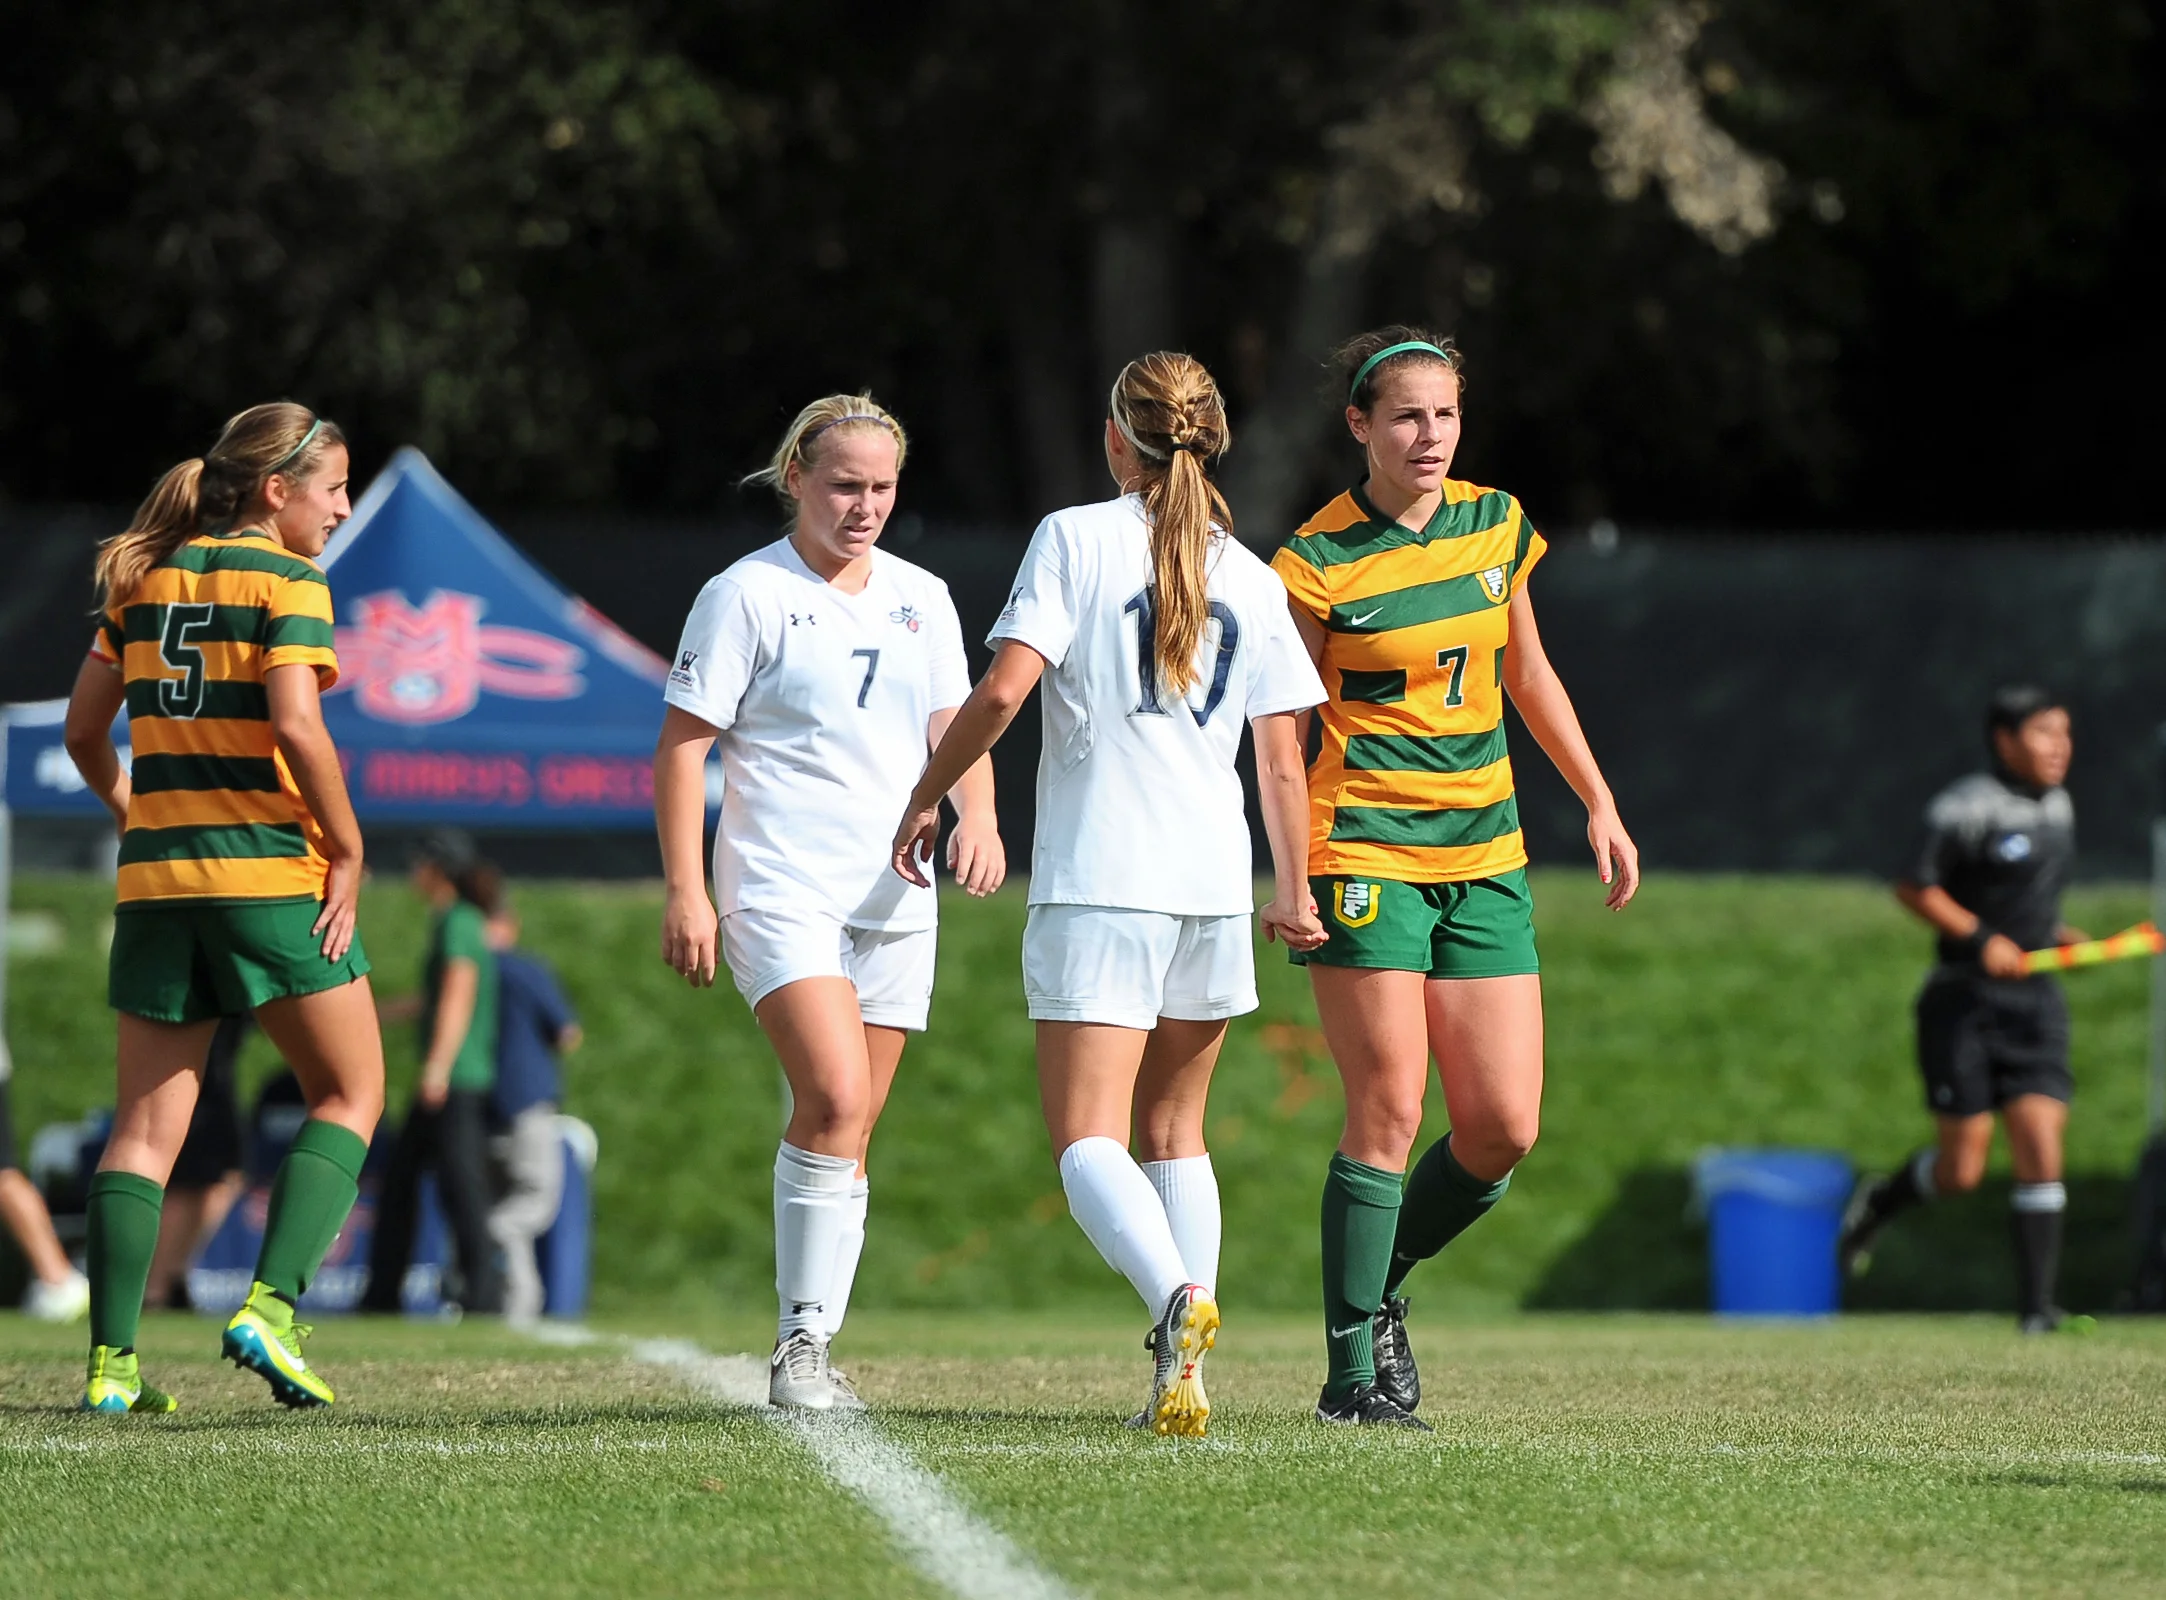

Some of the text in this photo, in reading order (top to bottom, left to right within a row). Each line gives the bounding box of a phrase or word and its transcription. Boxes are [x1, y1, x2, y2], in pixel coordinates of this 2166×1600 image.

[157, 601, 215, 721] 5
[851, 648, 880, 709] 7
[1122, 581, 1241, 730] 10
[1435, 643, 1469, 709] 7
